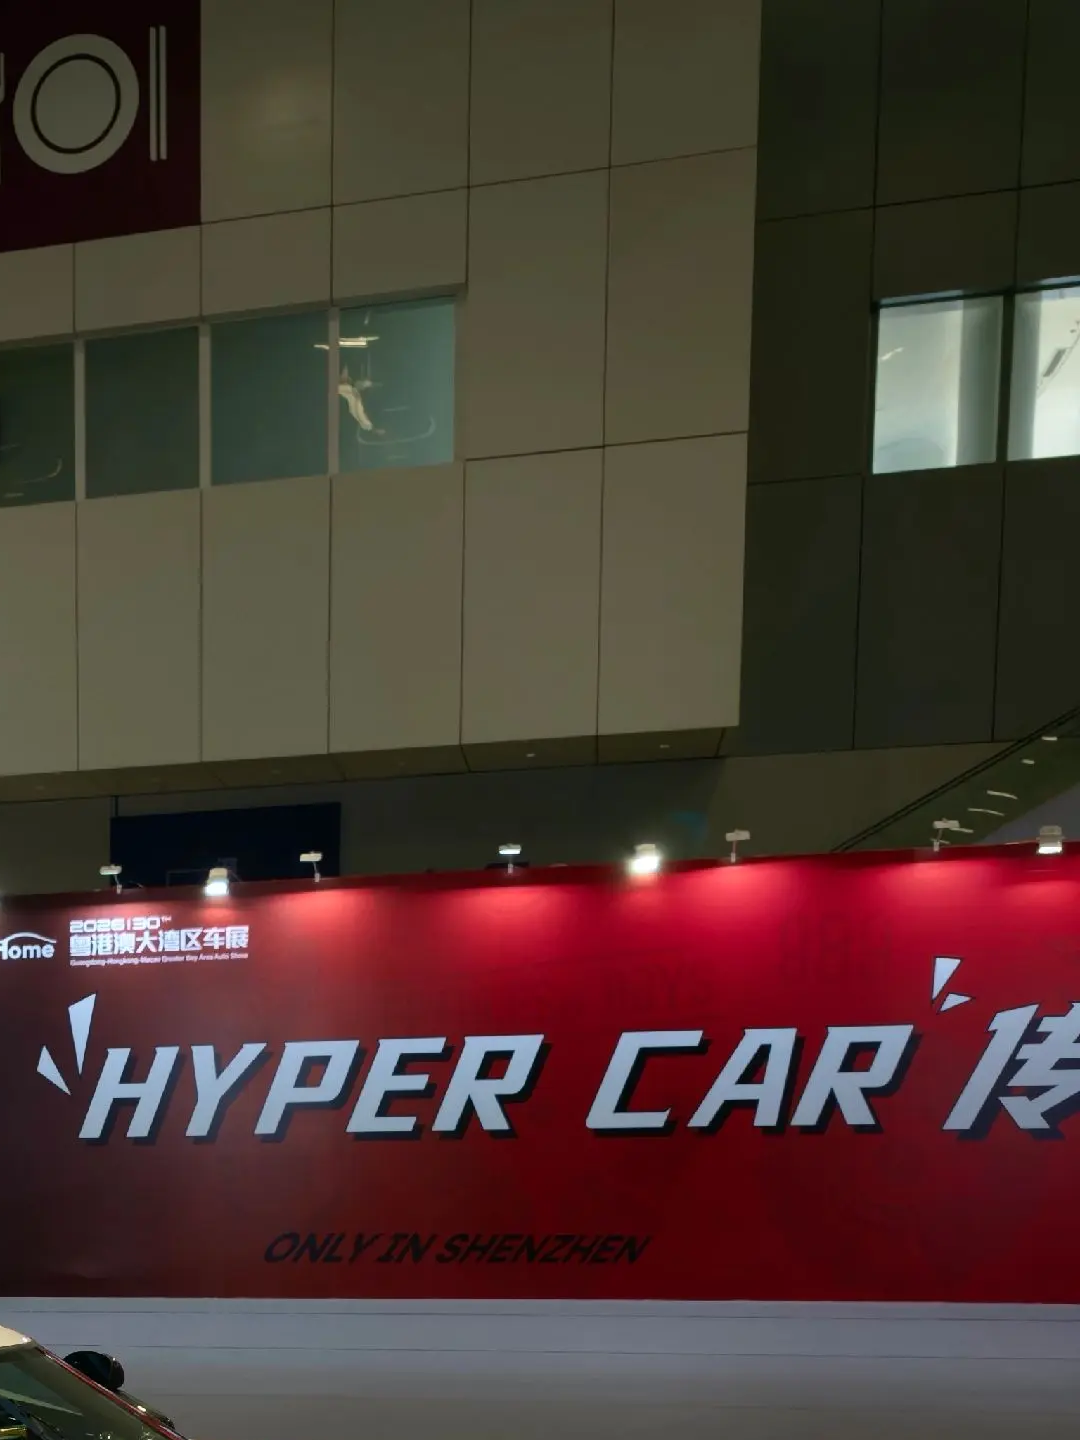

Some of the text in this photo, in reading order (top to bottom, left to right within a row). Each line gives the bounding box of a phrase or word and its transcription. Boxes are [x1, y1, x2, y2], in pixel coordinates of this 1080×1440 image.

[70, 925, 249, 957] 粤港澳大湾区车展
[78, 1034, 547, 1142] HYPER
[586, 1025, 918, 1133] CAR
[264, 1232, 653, 1265] ONLY IN SHENZHEN
